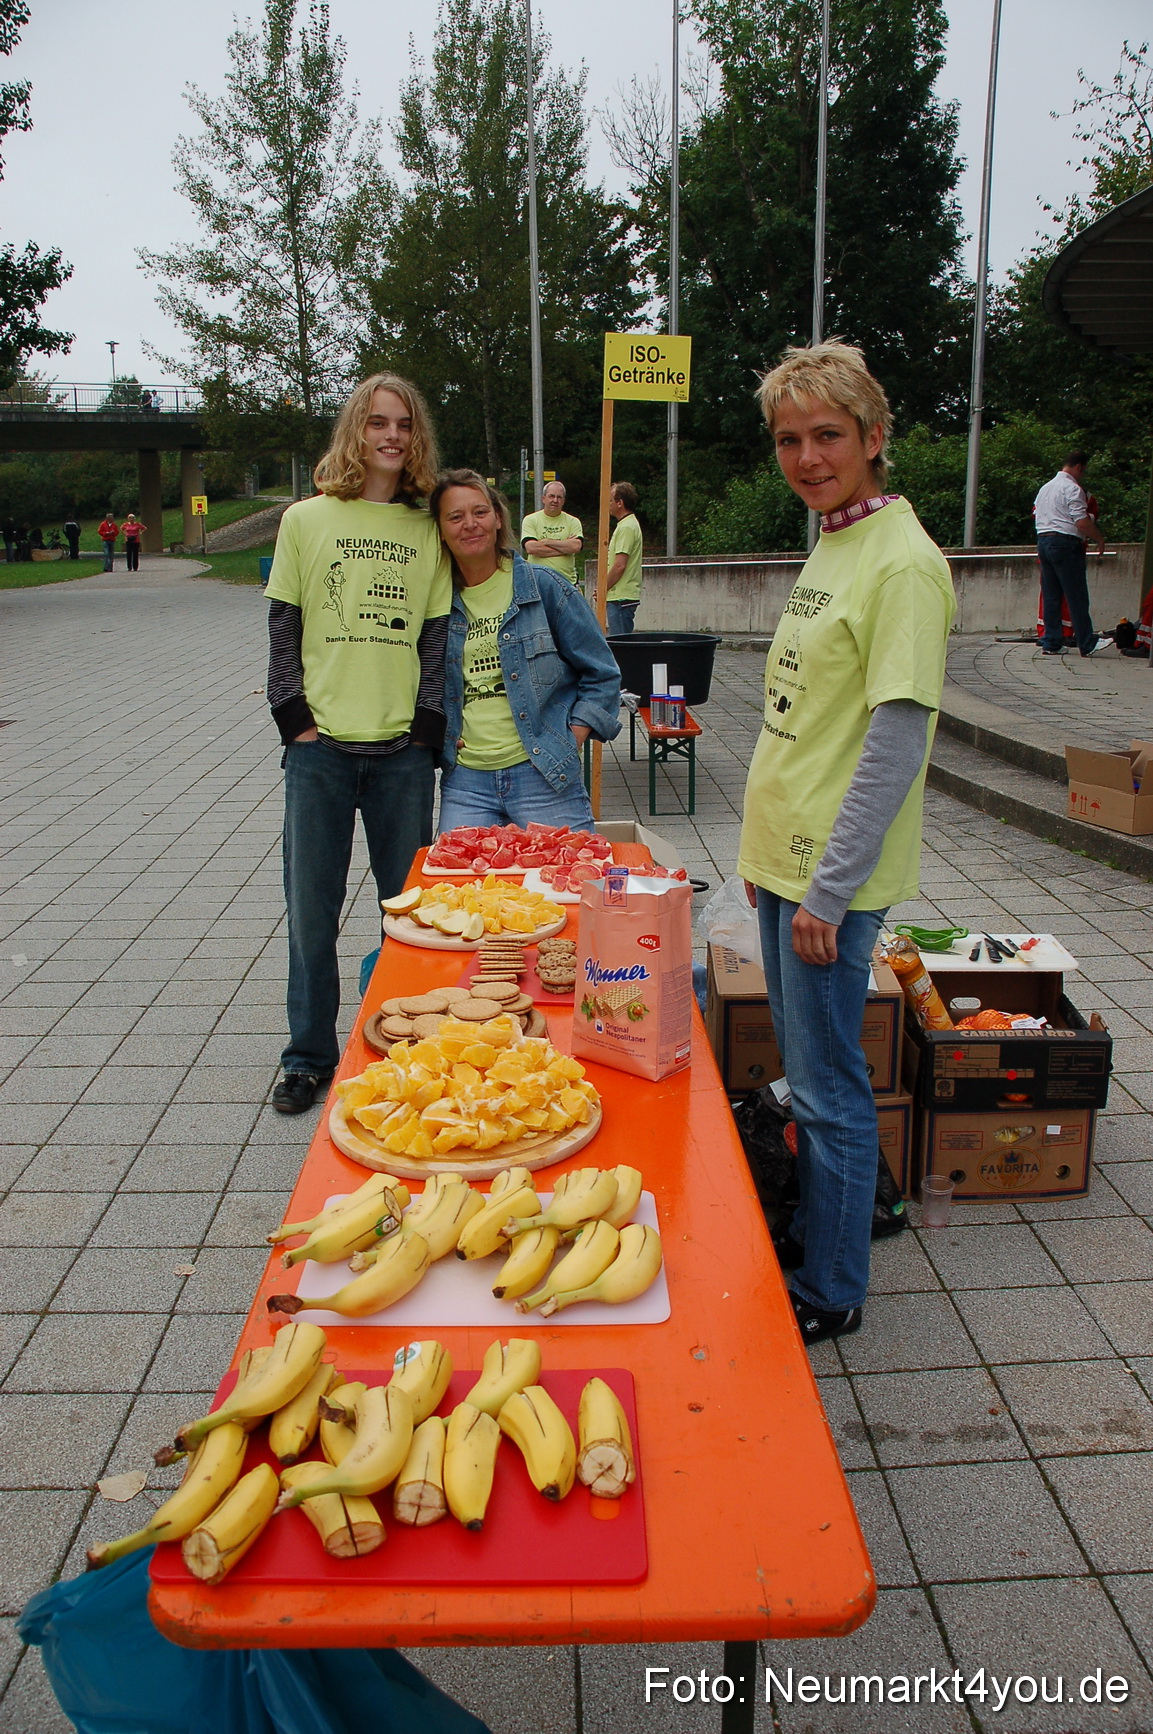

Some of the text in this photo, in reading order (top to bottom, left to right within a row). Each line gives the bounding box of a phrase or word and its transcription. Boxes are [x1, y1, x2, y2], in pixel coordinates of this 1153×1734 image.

[629, 345, 667, 364] ISO-
[608, 365, 686, 385] Getränke
[336, 538, 418, 559] NEUMARKTER
[342, 548, 411, 566] STADTLAUF
[467, 612, 505, 633] MARKTE
[348, 635, 368, 643] Euer
[585, 957, 651, 988] Manner
[605, 1022, 630, 1034] Original
[605, 1029, 647, 1044] Neapolitaner
[959, 1029, 1077, 1038] CARIBBEAN RED
[980, 1163, 1040, 1175] FAVORITA
